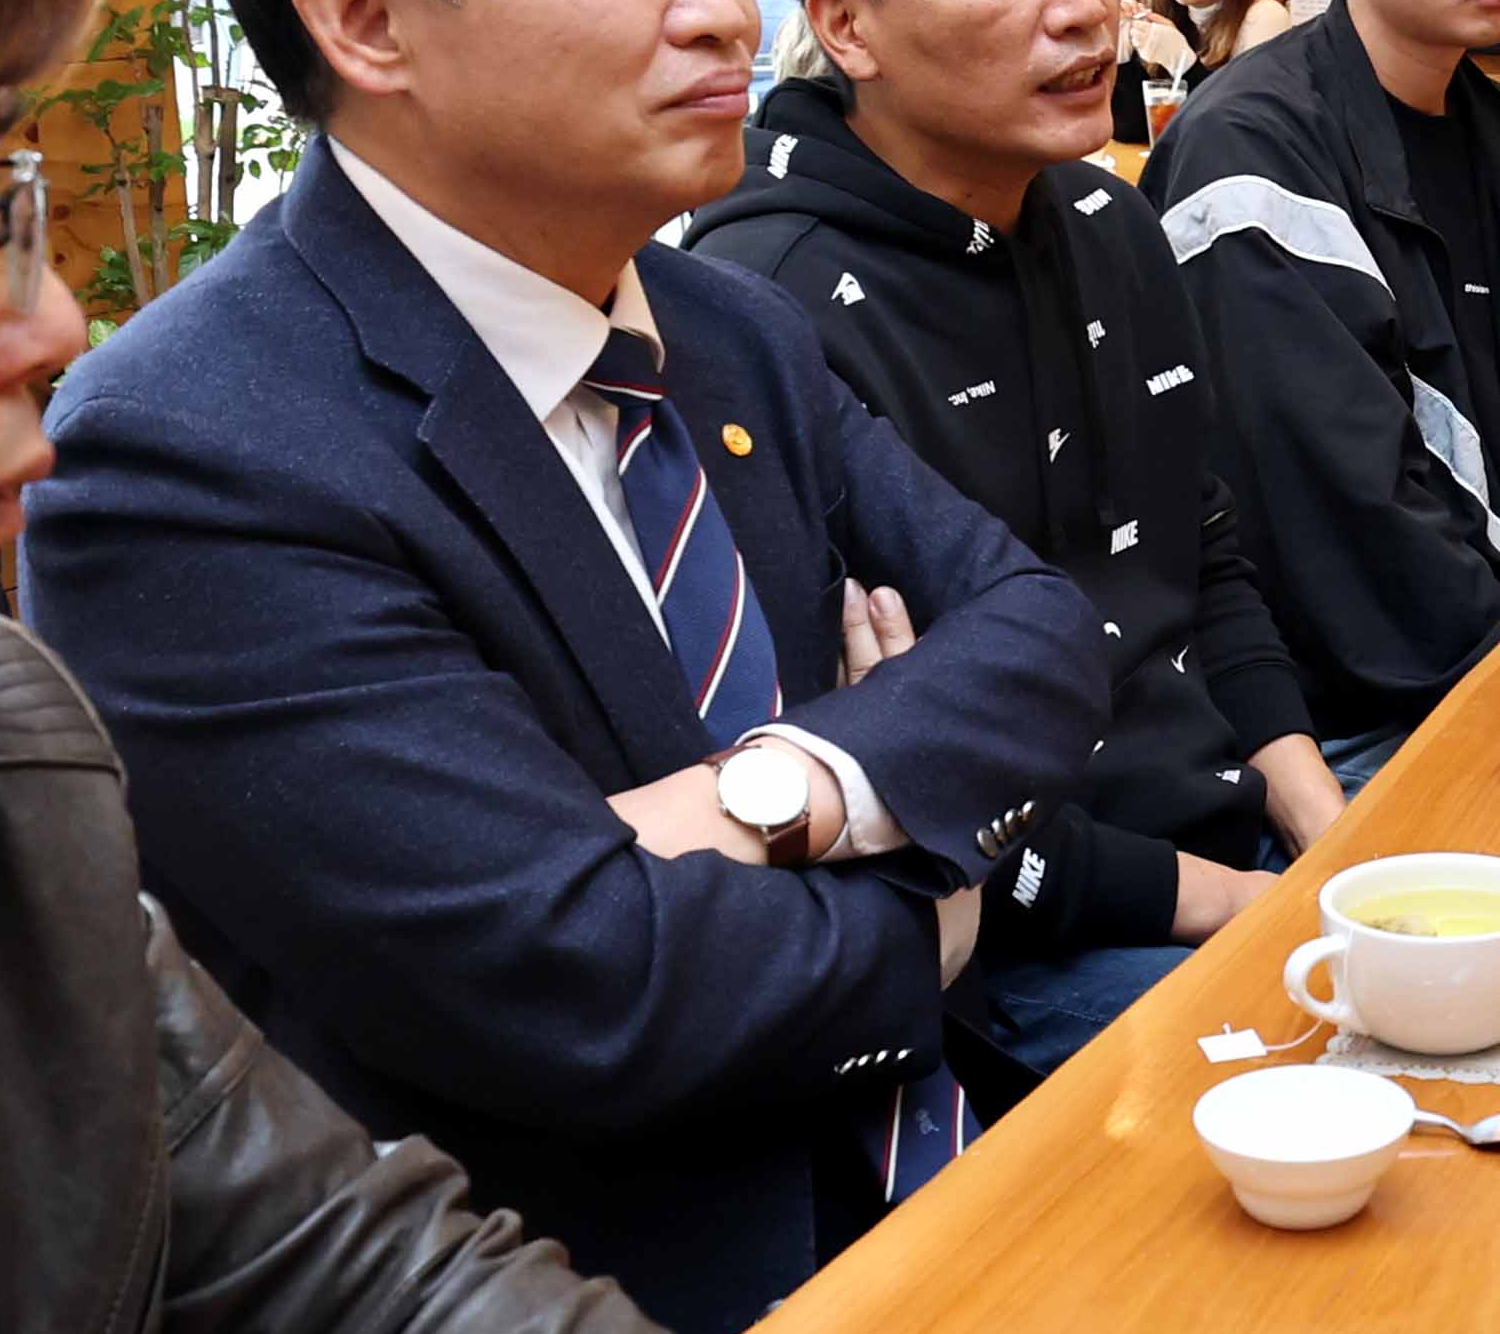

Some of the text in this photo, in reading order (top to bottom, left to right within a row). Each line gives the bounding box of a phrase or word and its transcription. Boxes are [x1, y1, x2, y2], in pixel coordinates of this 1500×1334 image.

[948, 380, 996, 406] Nike, Inc.
[1111, 520, 1138, 555] NIKE
[1012, 847, 1046, 909] NIKE
